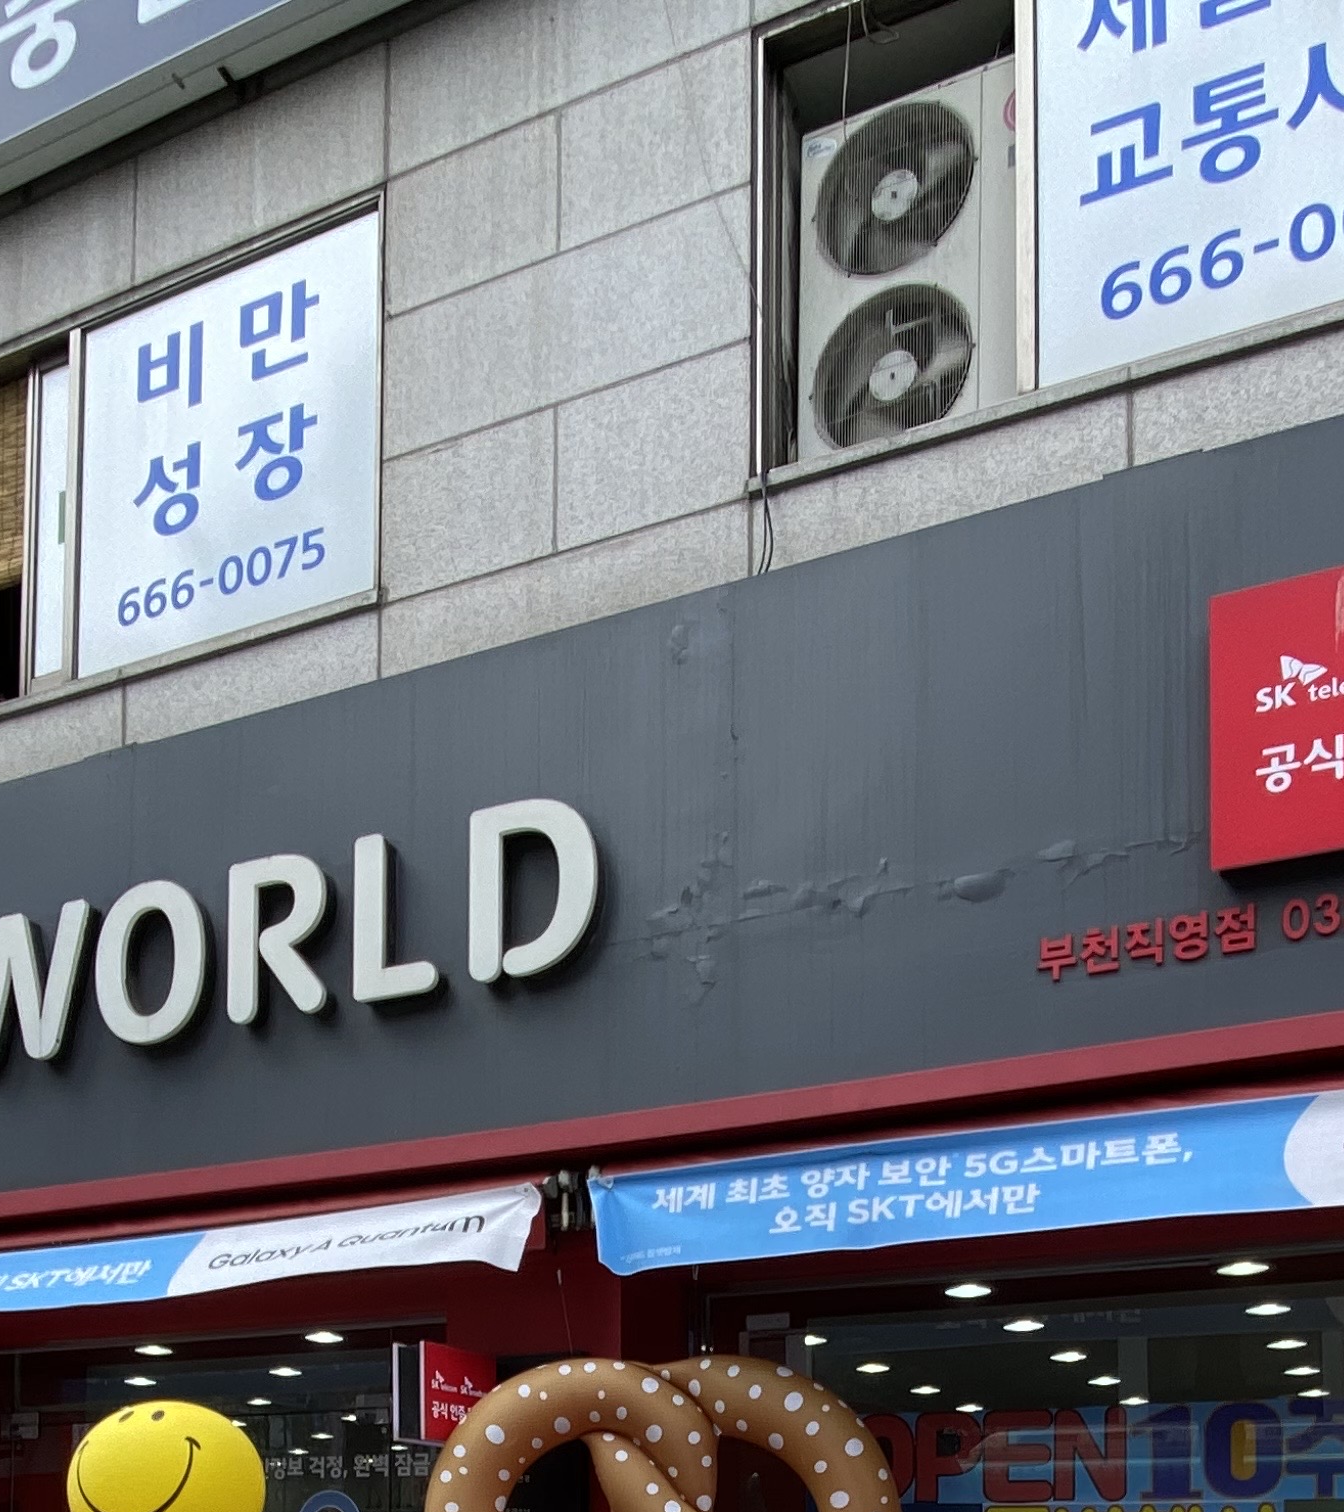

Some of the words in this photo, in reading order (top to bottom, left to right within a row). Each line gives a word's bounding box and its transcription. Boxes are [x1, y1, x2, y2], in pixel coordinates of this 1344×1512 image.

[136, 279, 319, 408] 비만
[133, 402, 318, 538] 성장
[116, 527, 328, 628] 666-0075
[1256, 681, 1298, 713] SK
[1038, 905, 1258, 982] 부천직영점
[652, 1184, 717, 1214] 세계
[726, 1174, 790, 1205] 최초
[800, 1163, 871, 1193] 양자
[878, 1154, 948, 1188] 보안
[964, 1131, 1193, 1177] 5G스마트폰,
[768, 1202, 838, 1236] 오직
[848, 1183, 1040, 1223] SKT에서만
[206, 1244, 316, 1270] Galaxy
[339, 1213, 486, 1248] Quantum
[264, 1456, 304, 1481] 정보
[395, 1453, 431, 1477] 잠금
